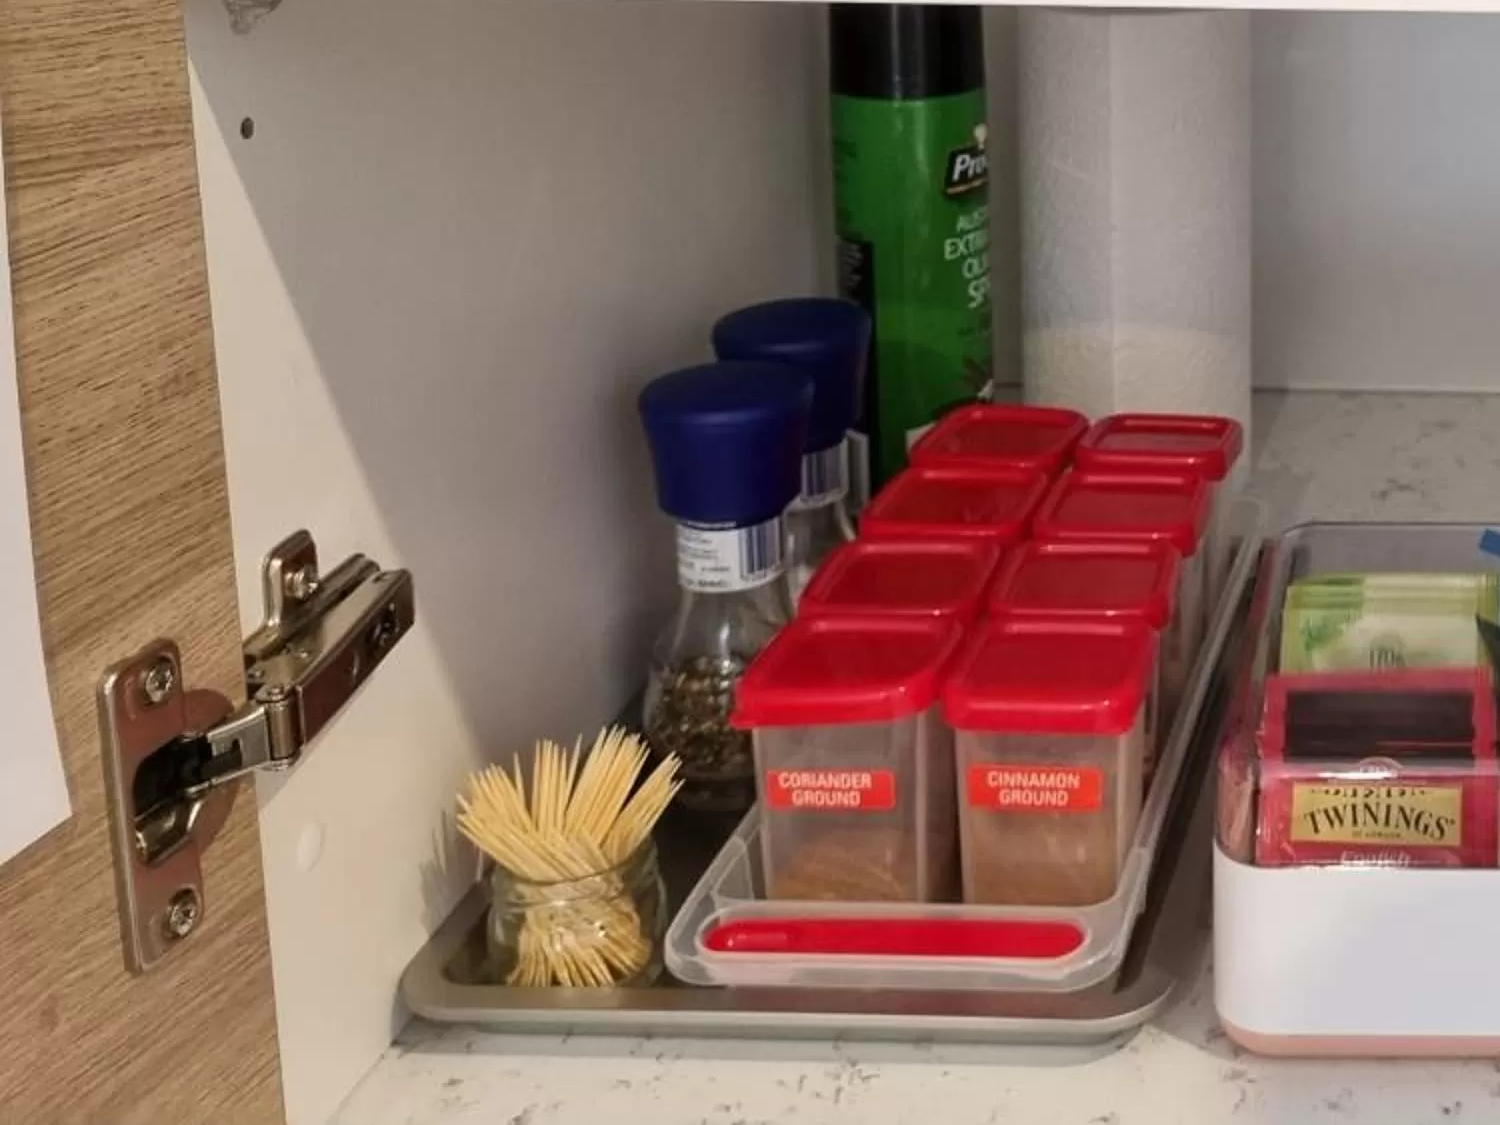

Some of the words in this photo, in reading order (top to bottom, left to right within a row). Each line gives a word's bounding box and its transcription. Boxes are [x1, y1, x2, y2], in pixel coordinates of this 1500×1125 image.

[778, 771, 873, 789] CORIANDER
[986, 770, 1080, 789] CINNAMON
[792, 789, 861, 807] GROUND
[998, 789, 1069, 807] GROUND
[1304, 801, 1452, 842] TWININGS
